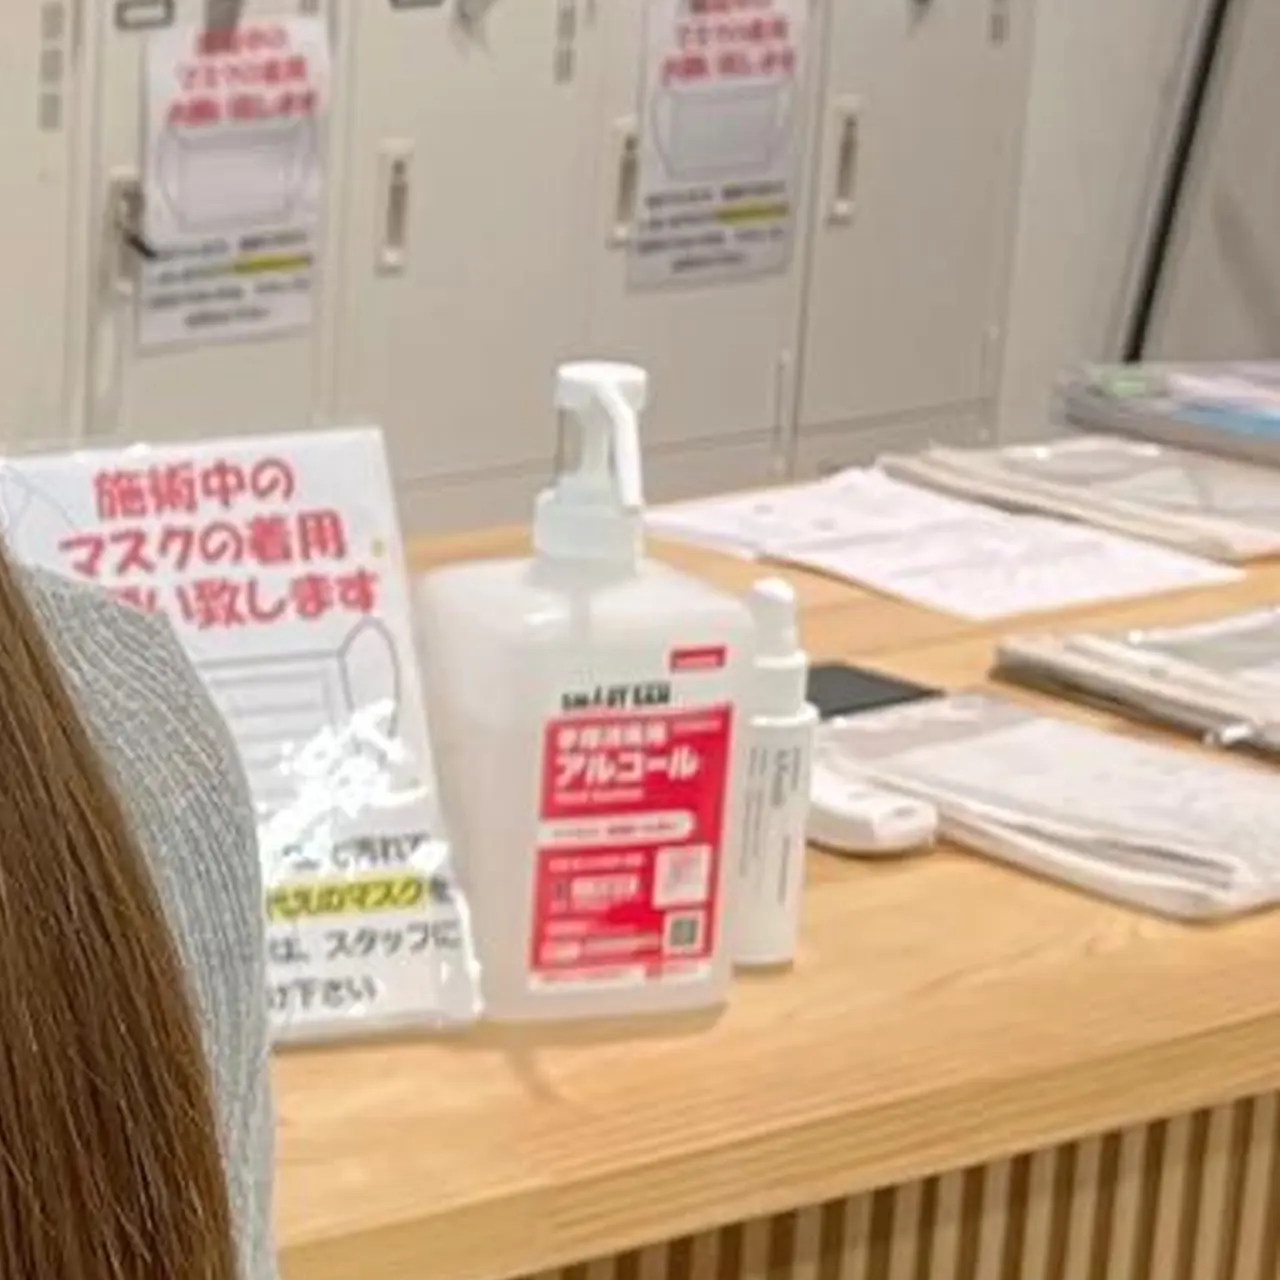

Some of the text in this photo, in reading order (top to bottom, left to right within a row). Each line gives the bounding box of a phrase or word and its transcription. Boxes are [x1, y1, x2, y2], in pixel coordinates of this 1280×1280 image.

[95, 457, 294, 520] 施術中の
[58, 509, 347, 577] マスクの着用
[554, 744, 699, 787] アルコール
